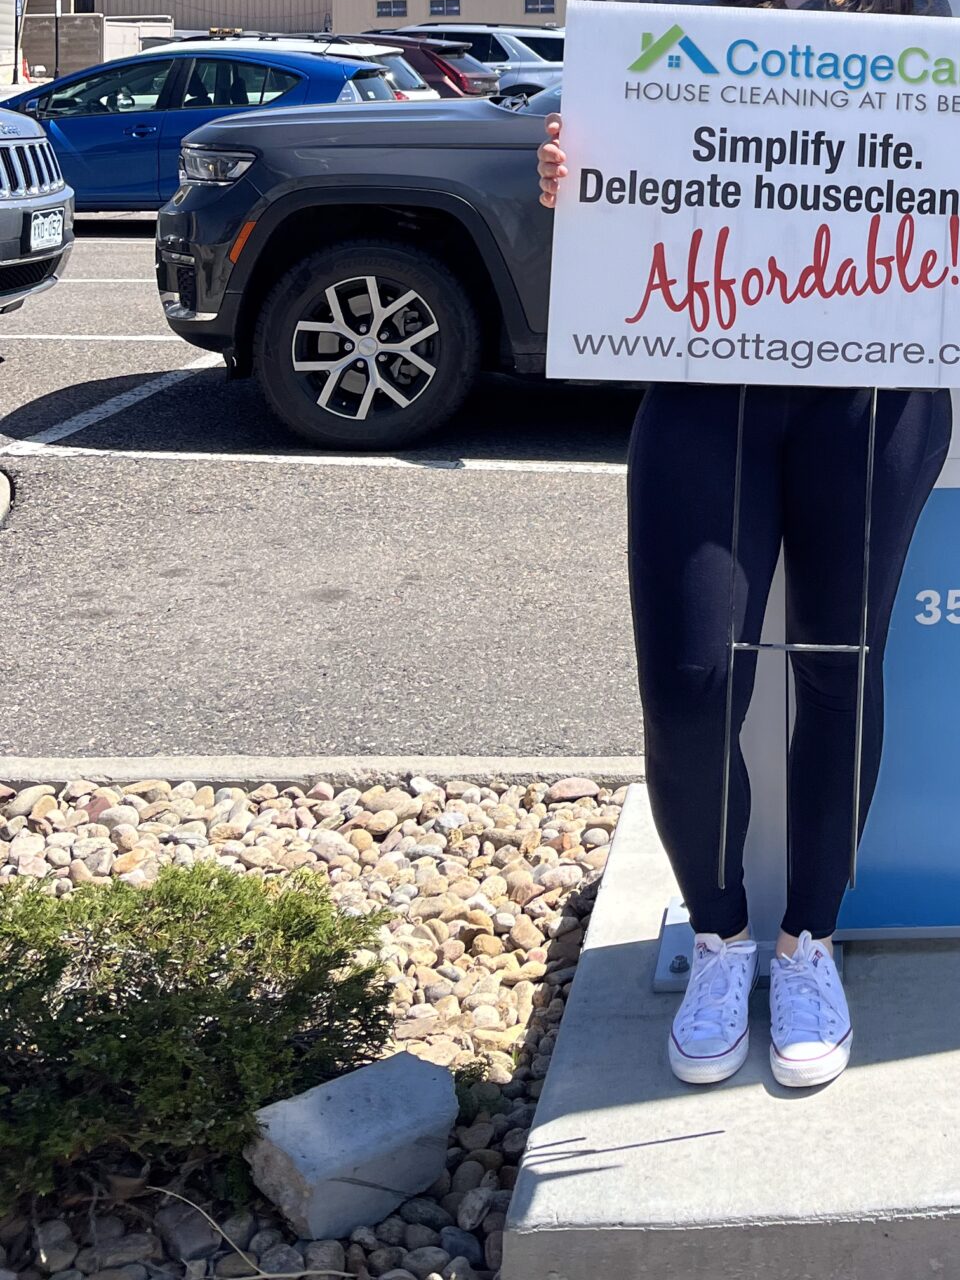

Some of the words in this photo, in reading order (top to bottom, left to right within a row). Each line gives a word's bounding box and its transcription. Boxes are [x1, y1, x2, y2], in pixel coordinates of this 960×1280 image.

[625, 81, 710, 103] HOUSE
[720, 85, 850, 109] CLEANING
[859, 91, 887, 111] AT
[896, 93, 927, 113] ITS
[693, 127, 845, 174] Simplify
[858, 133, 922, 169] life.
[580, 168, 741, 213] Delegate
[625, 214, 959, 332] Affordable!
